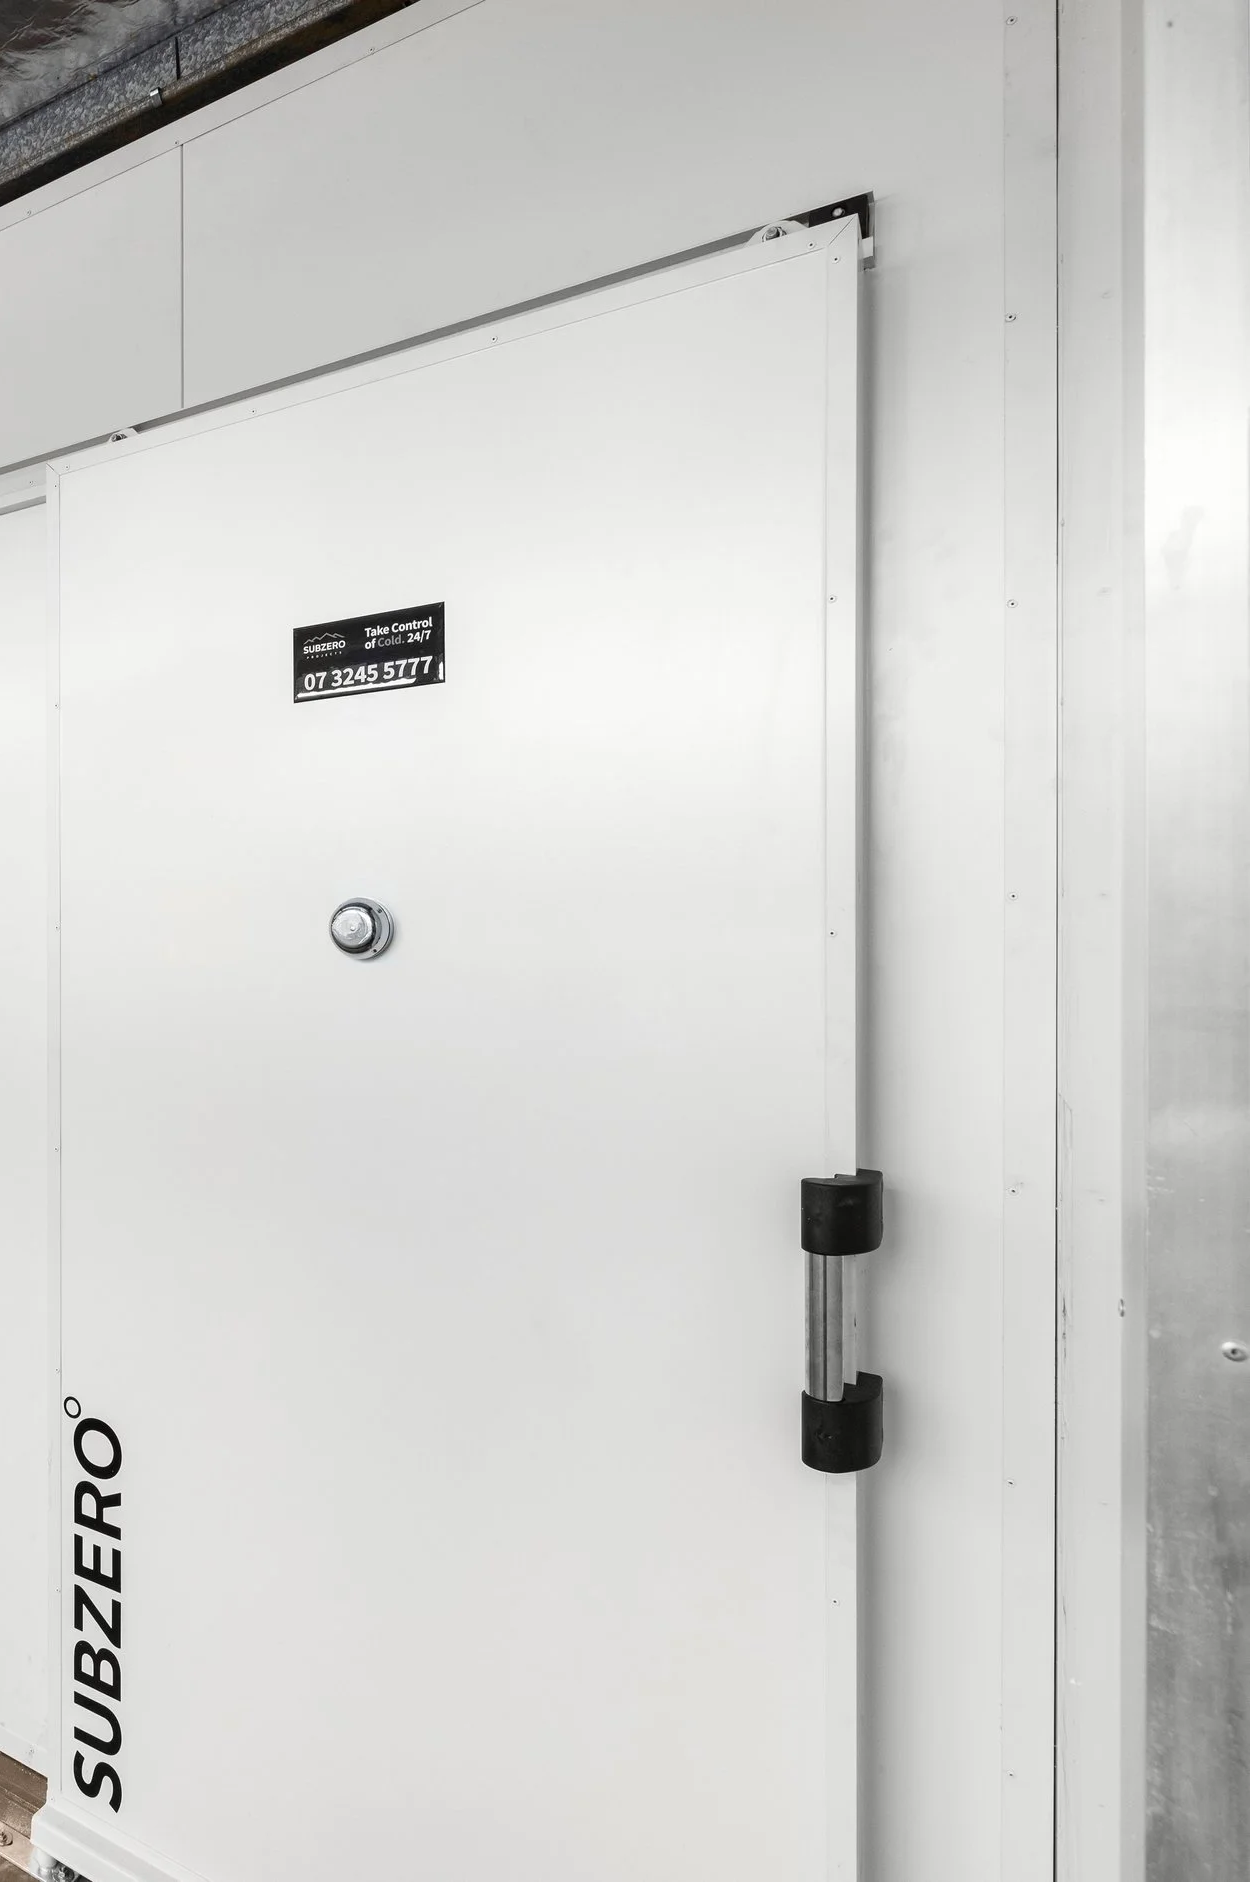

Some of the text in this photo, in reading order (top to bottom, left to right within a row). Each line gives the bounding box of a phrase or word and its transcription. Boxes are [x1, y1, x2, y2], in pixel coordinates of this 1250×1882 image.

[364, 616, 433, 638] Take Control
[303, 640, 346, 654] SUBZERO
[364, 629, 431, 650] of Cold. 24/7
[304, 655, 433, 691] 07 3245 5777
